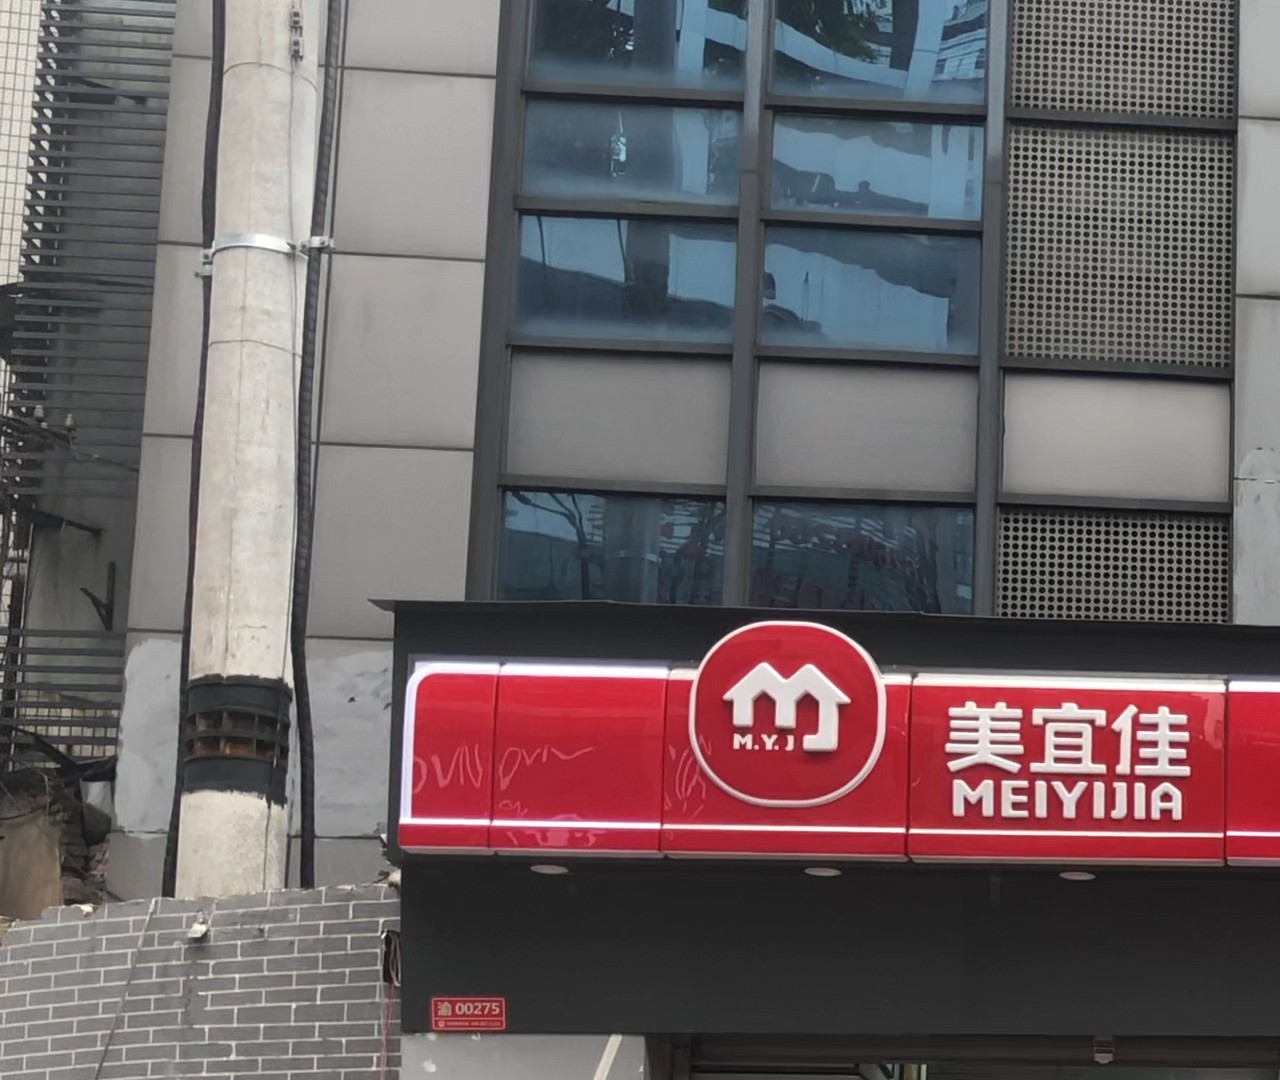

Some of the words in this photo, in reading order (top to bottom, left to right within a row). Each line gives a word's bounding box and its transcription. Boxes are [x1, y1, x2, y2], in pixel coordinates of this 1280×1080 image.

[945, 701, 1191, 777] 美宜佳
[952, 778, 1183, 820] MEIYIJIA
[455, 1002, 500, 1015] 00275
